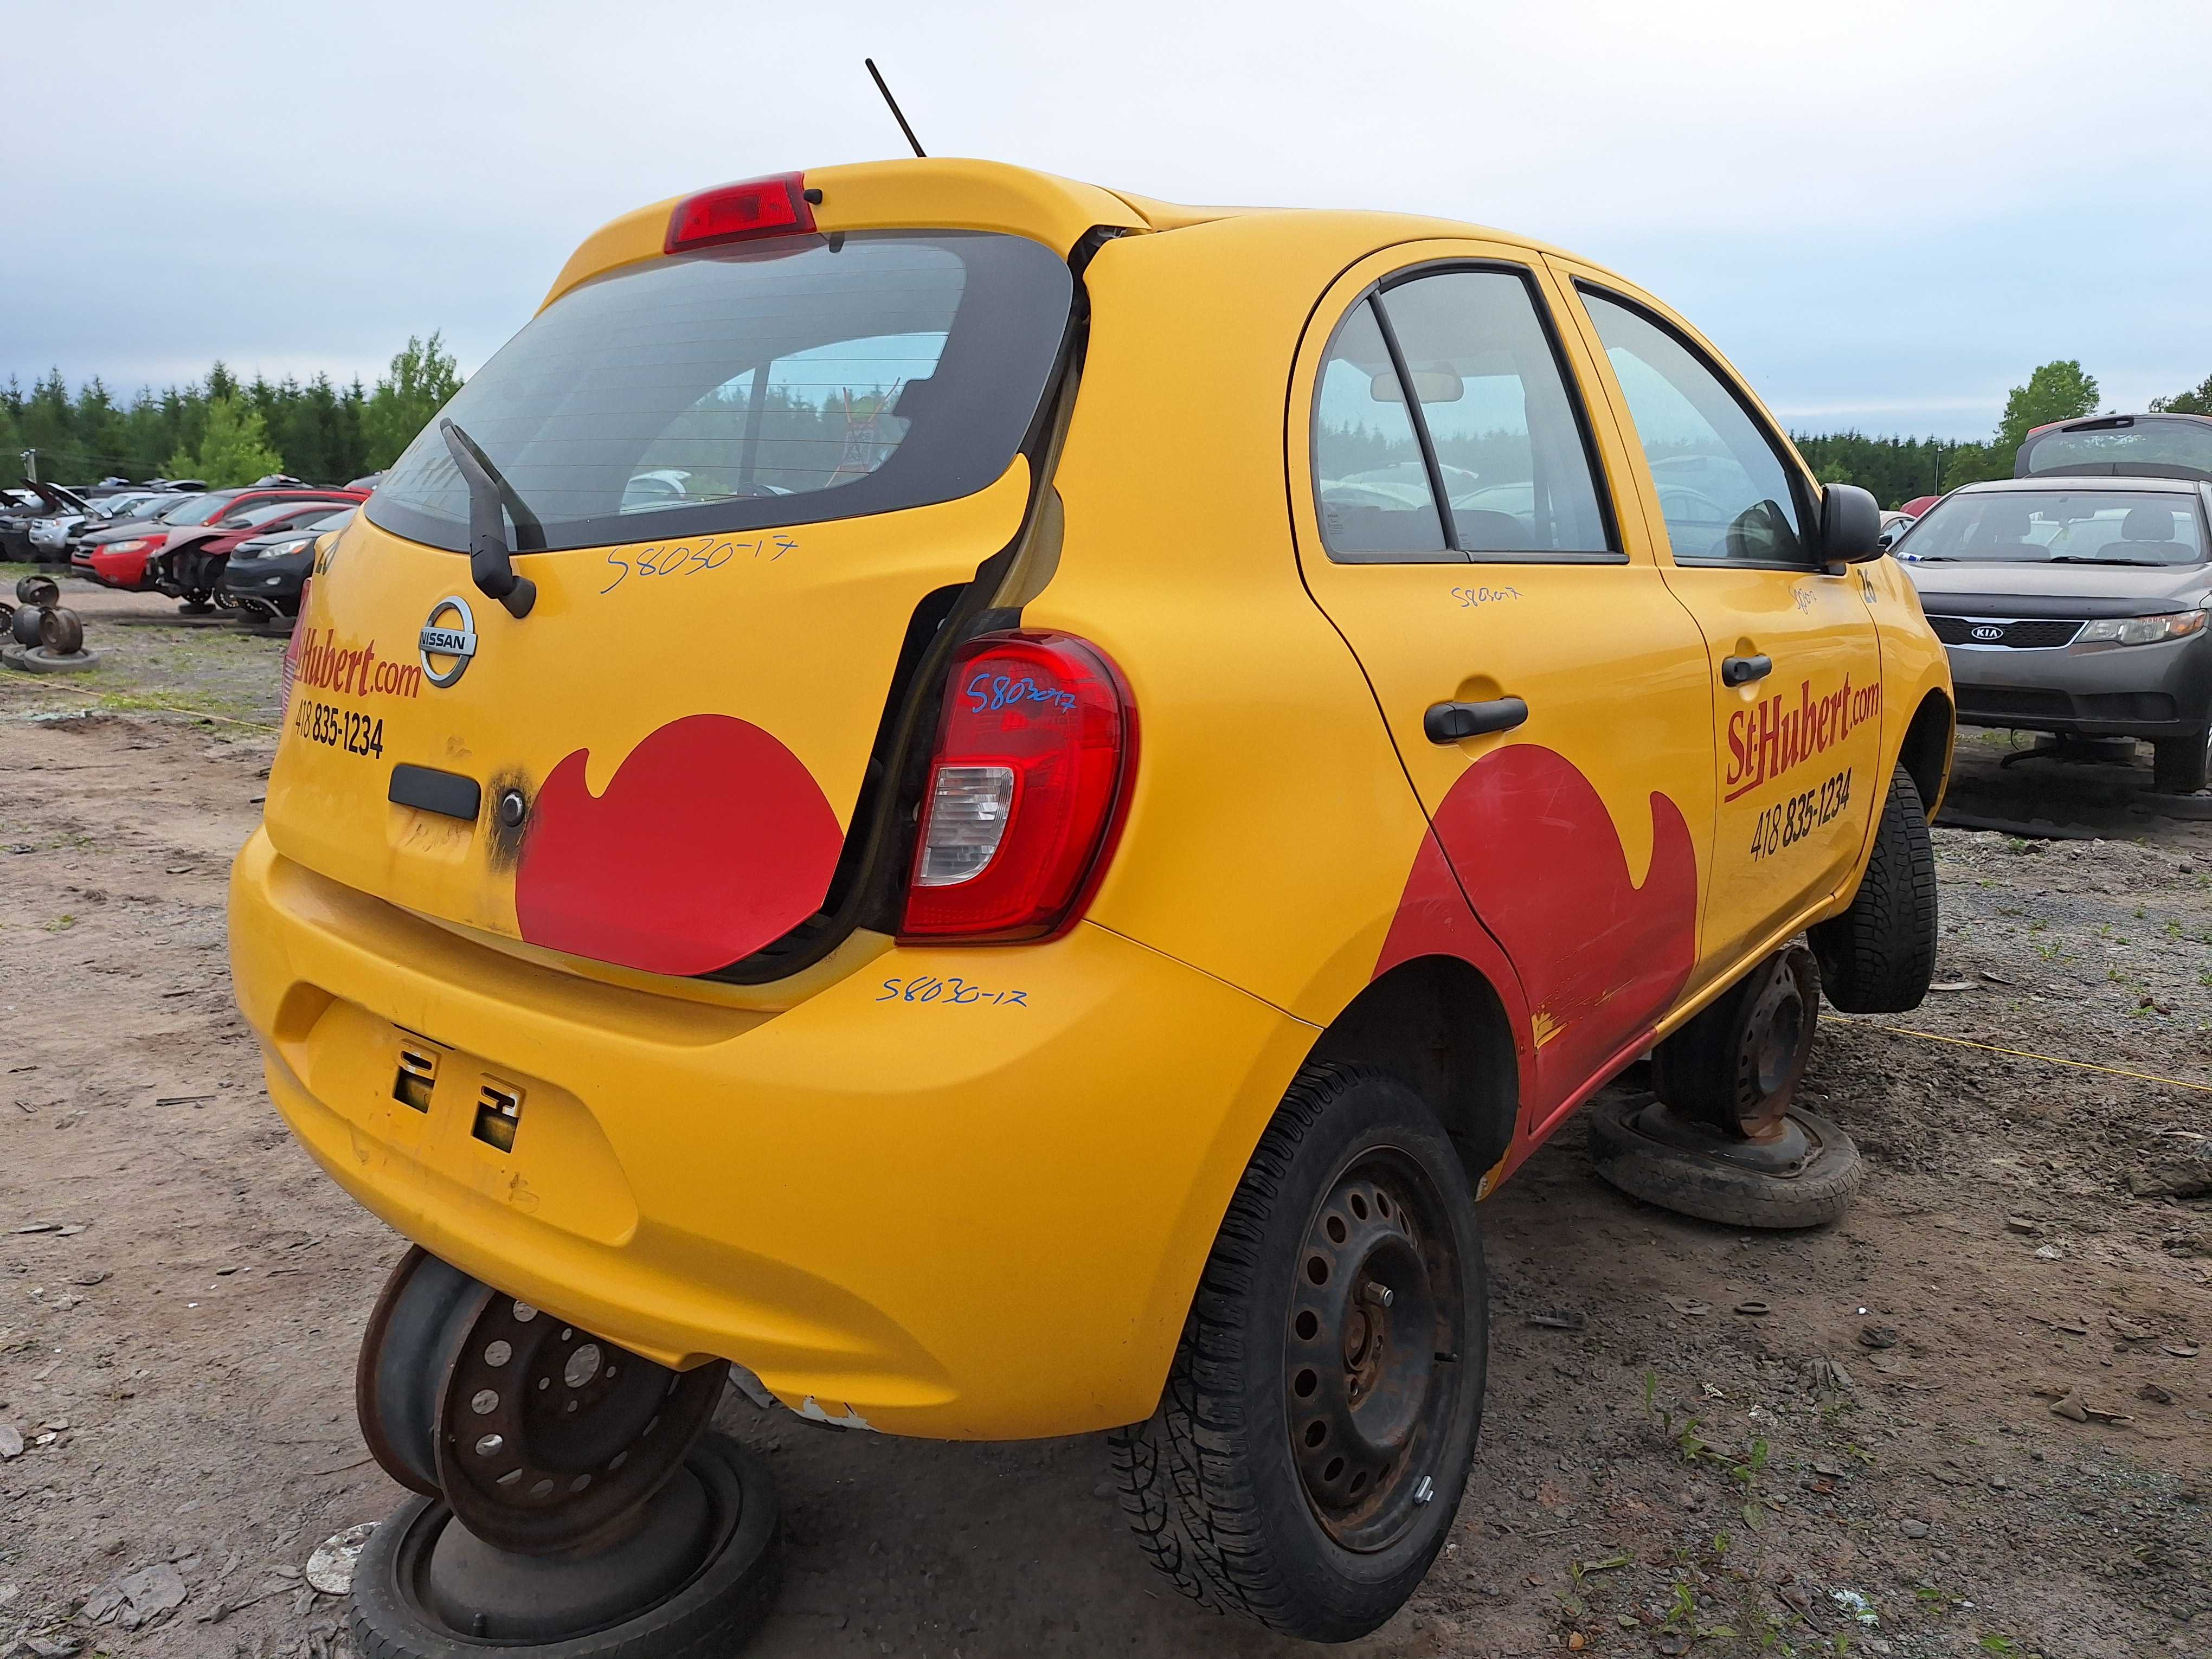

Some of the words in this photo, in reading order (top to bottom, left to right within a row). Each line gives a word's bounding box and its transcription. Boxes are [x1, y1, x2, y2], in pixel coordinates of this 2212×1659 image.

[420, 631, 466, 650] NISSAN
[1976, 629, 1997, 637] KIA
[295, 698, 312, 738] 418
[312, 703, 383, 760] 835-1234
[1751, 803, 1782, 862] 418
[1782, 767, 1851, 848] 835-1234
